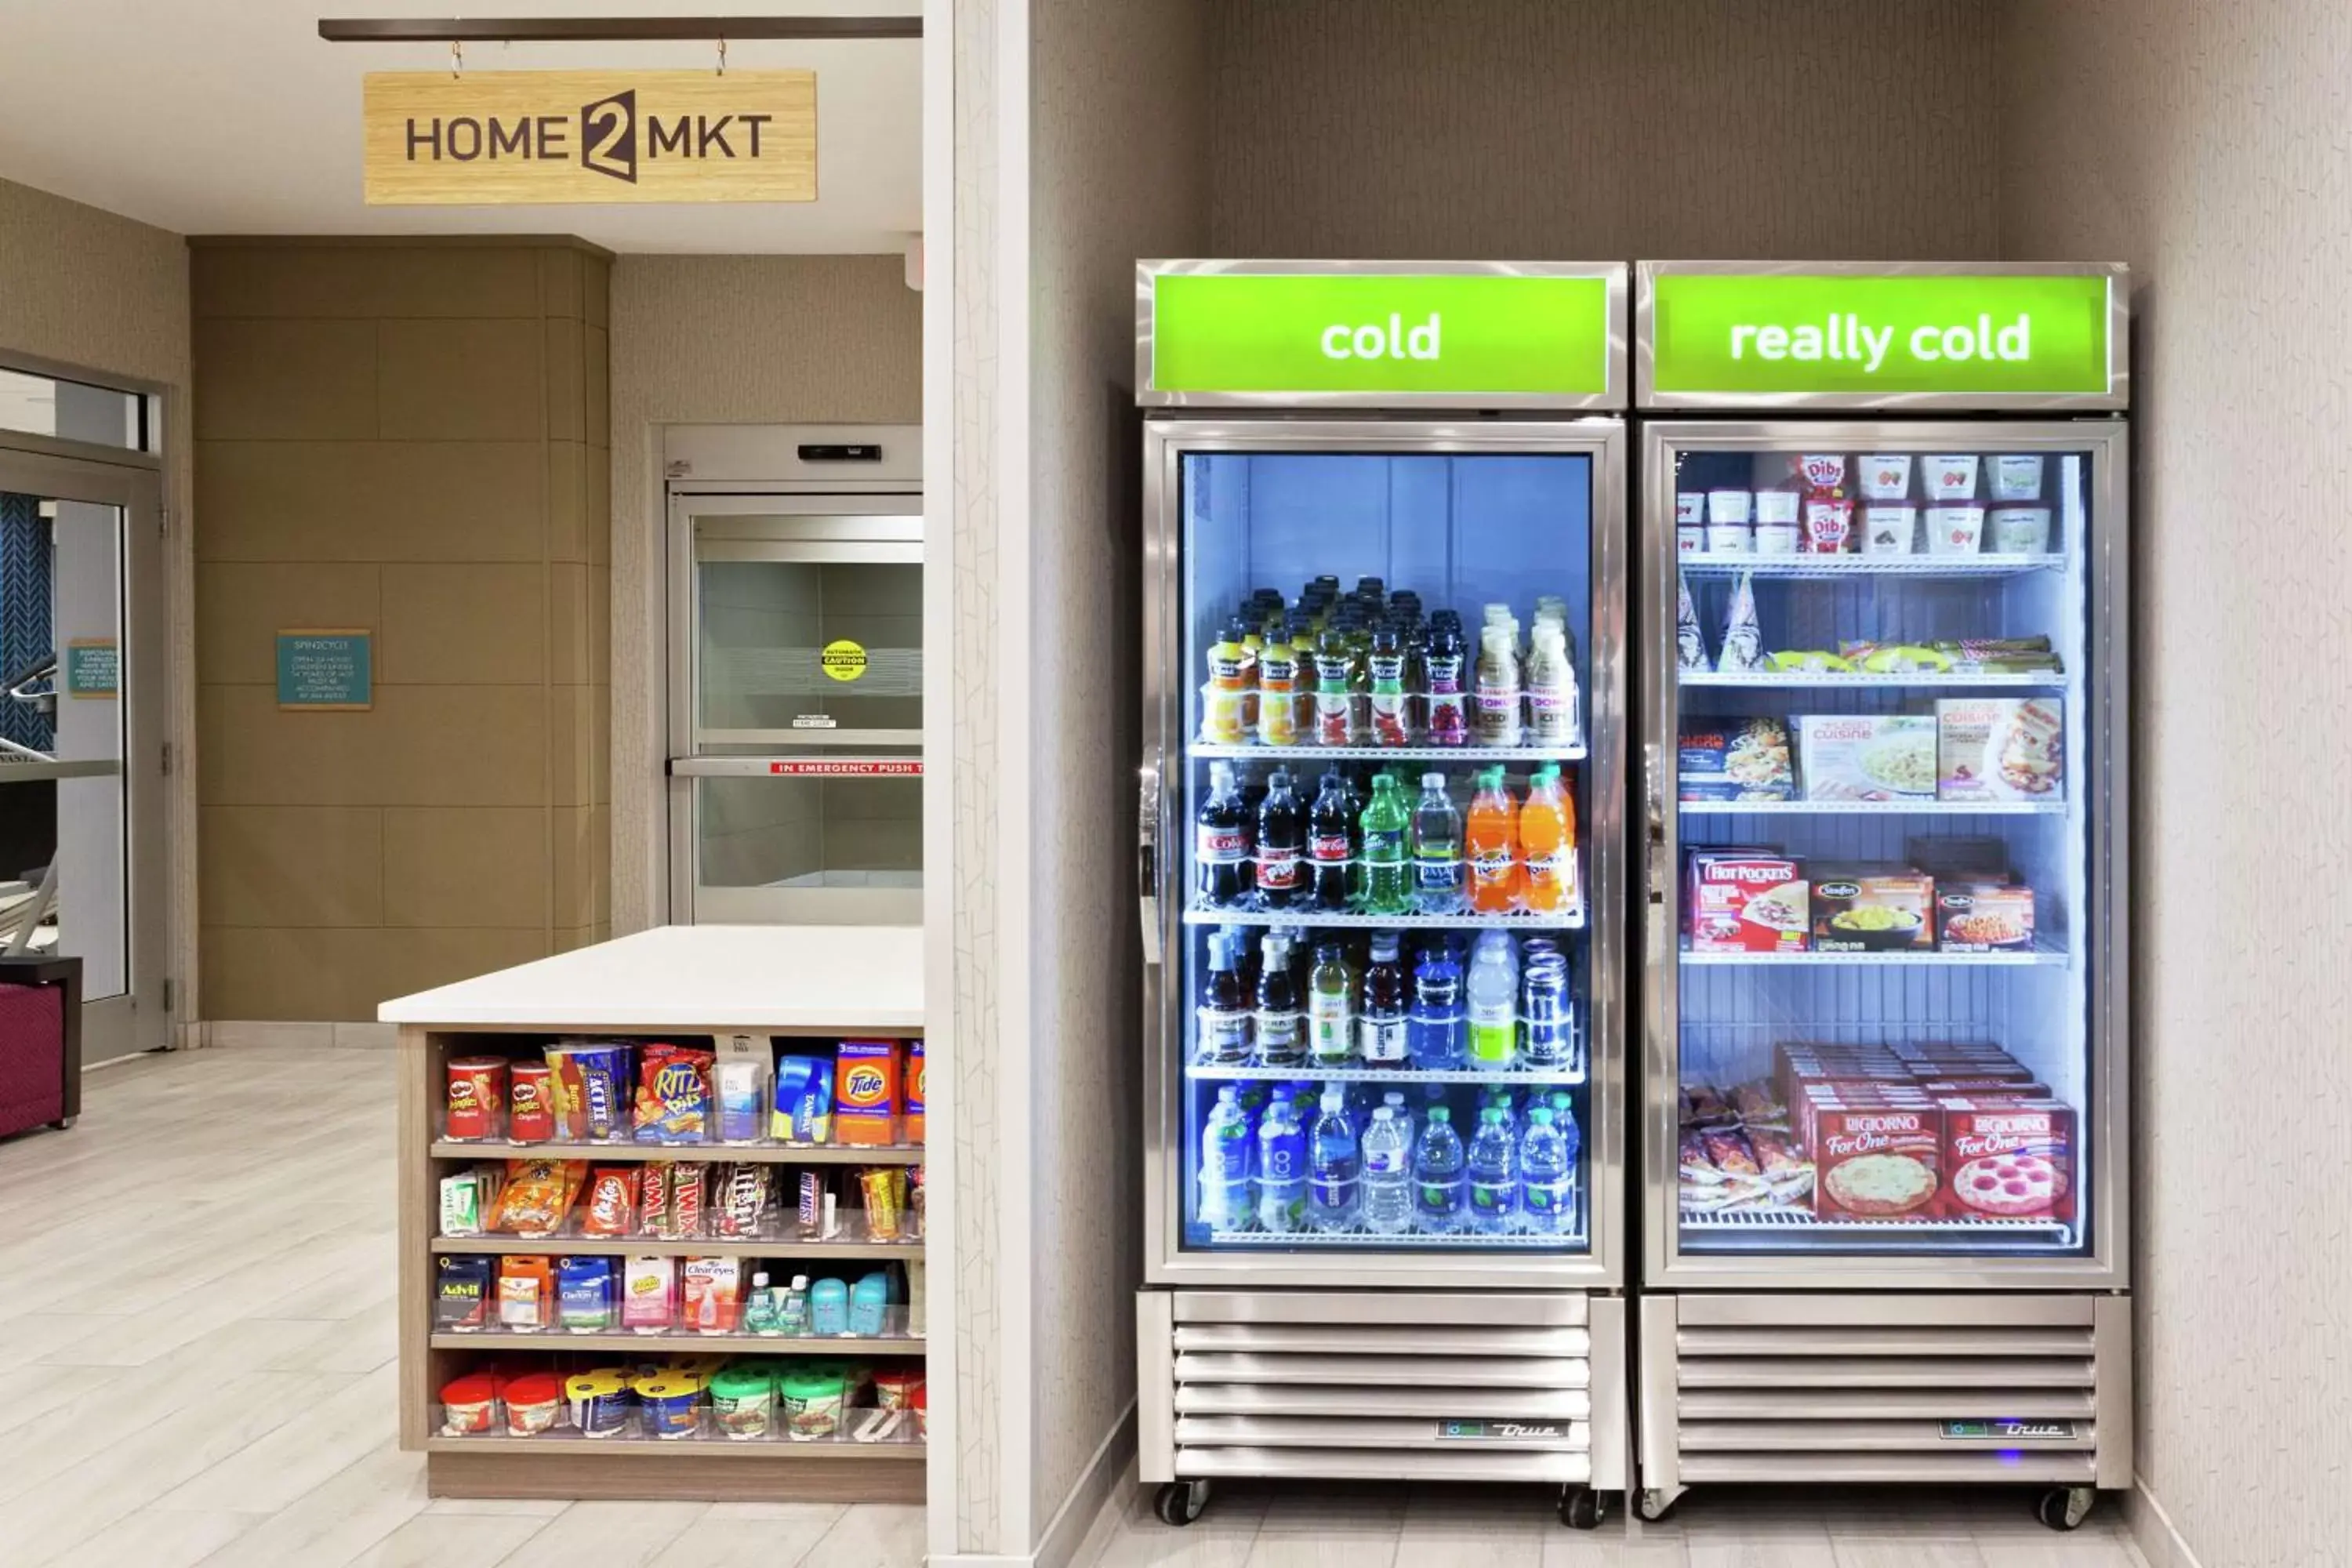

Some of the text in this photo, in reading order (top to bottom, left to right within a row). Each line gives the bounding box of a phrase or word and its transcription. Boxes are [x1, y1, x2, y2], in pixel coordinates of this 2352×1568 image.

[407, 116, 568, 161] HOME
[648, 114, 772, 158] MKT
[1321, 313, 1441, 360] cold
[1730, 313, 2031, 373] really cold
[779, 764, 793, 772] IN
[878, 764, 912, 772] PUSH
[654, 1069, 702, 1098] RITZ
[850, 1075, 882, 1095] Tide
[444, 1186, 456, 1229] WHITE
[675, 1177, 699, 1233] TWIX
[688, 1265, 735, 1276] Clear eyes
[441, 1284, 480, 1296] Advil
